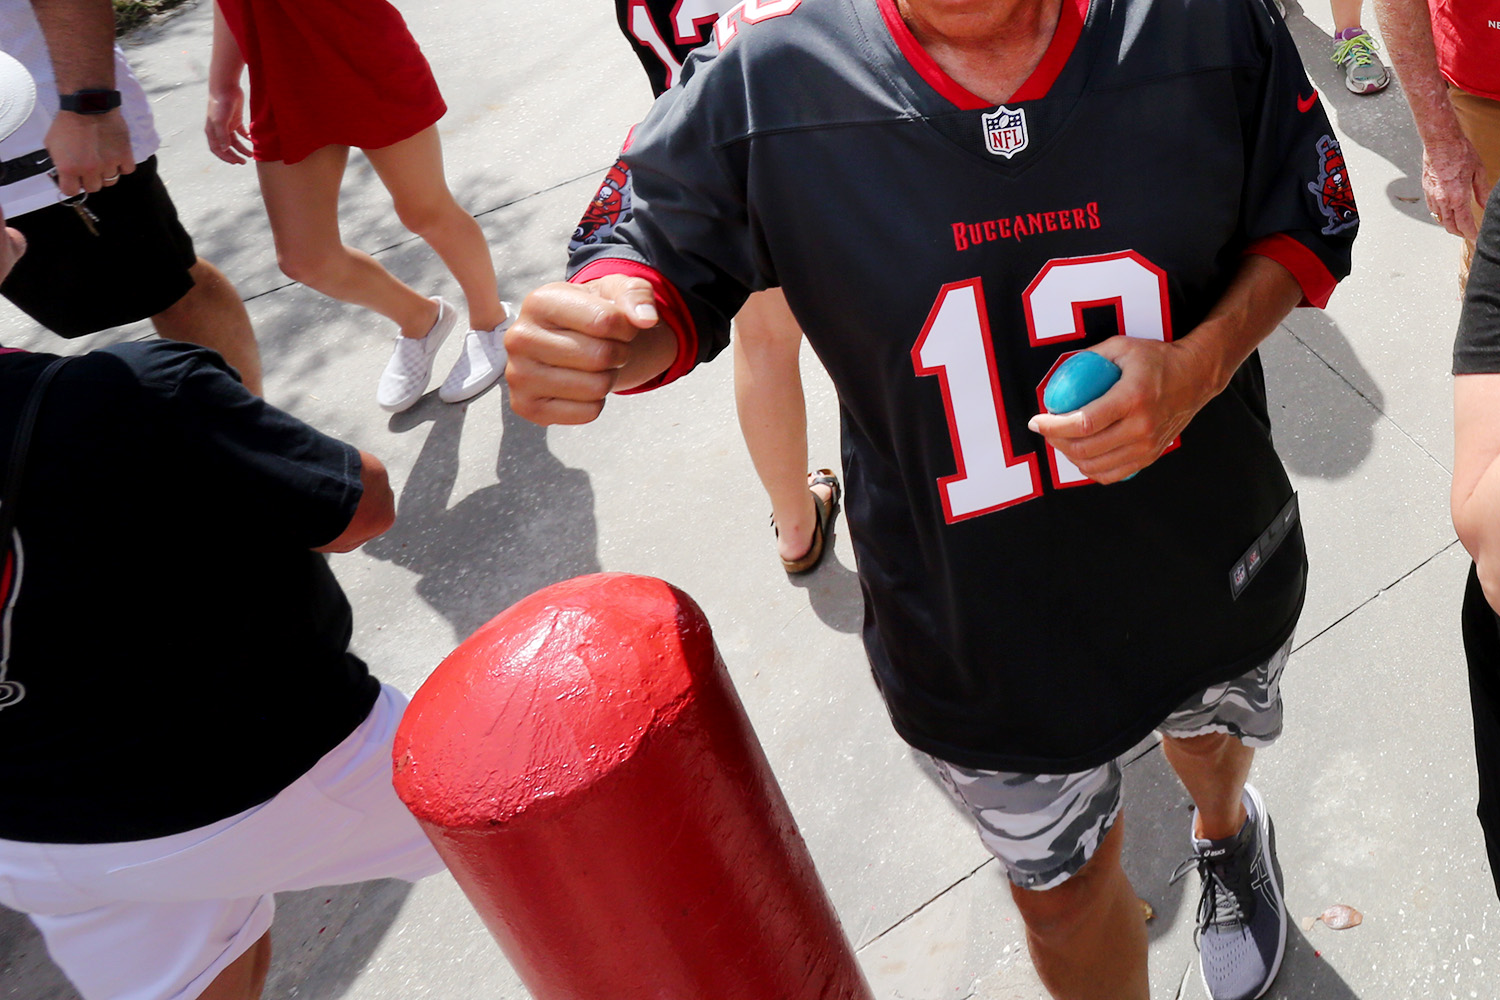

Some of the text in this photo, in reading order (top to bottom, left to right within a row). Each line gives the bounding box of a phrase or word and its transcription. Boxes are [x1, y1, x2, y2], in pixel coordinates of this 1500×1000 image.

[991, 129, 1022, 149] NFL
[951, 201, 1101, 252] BUCCANEERS
[910, 248, 1181, 525] 12
